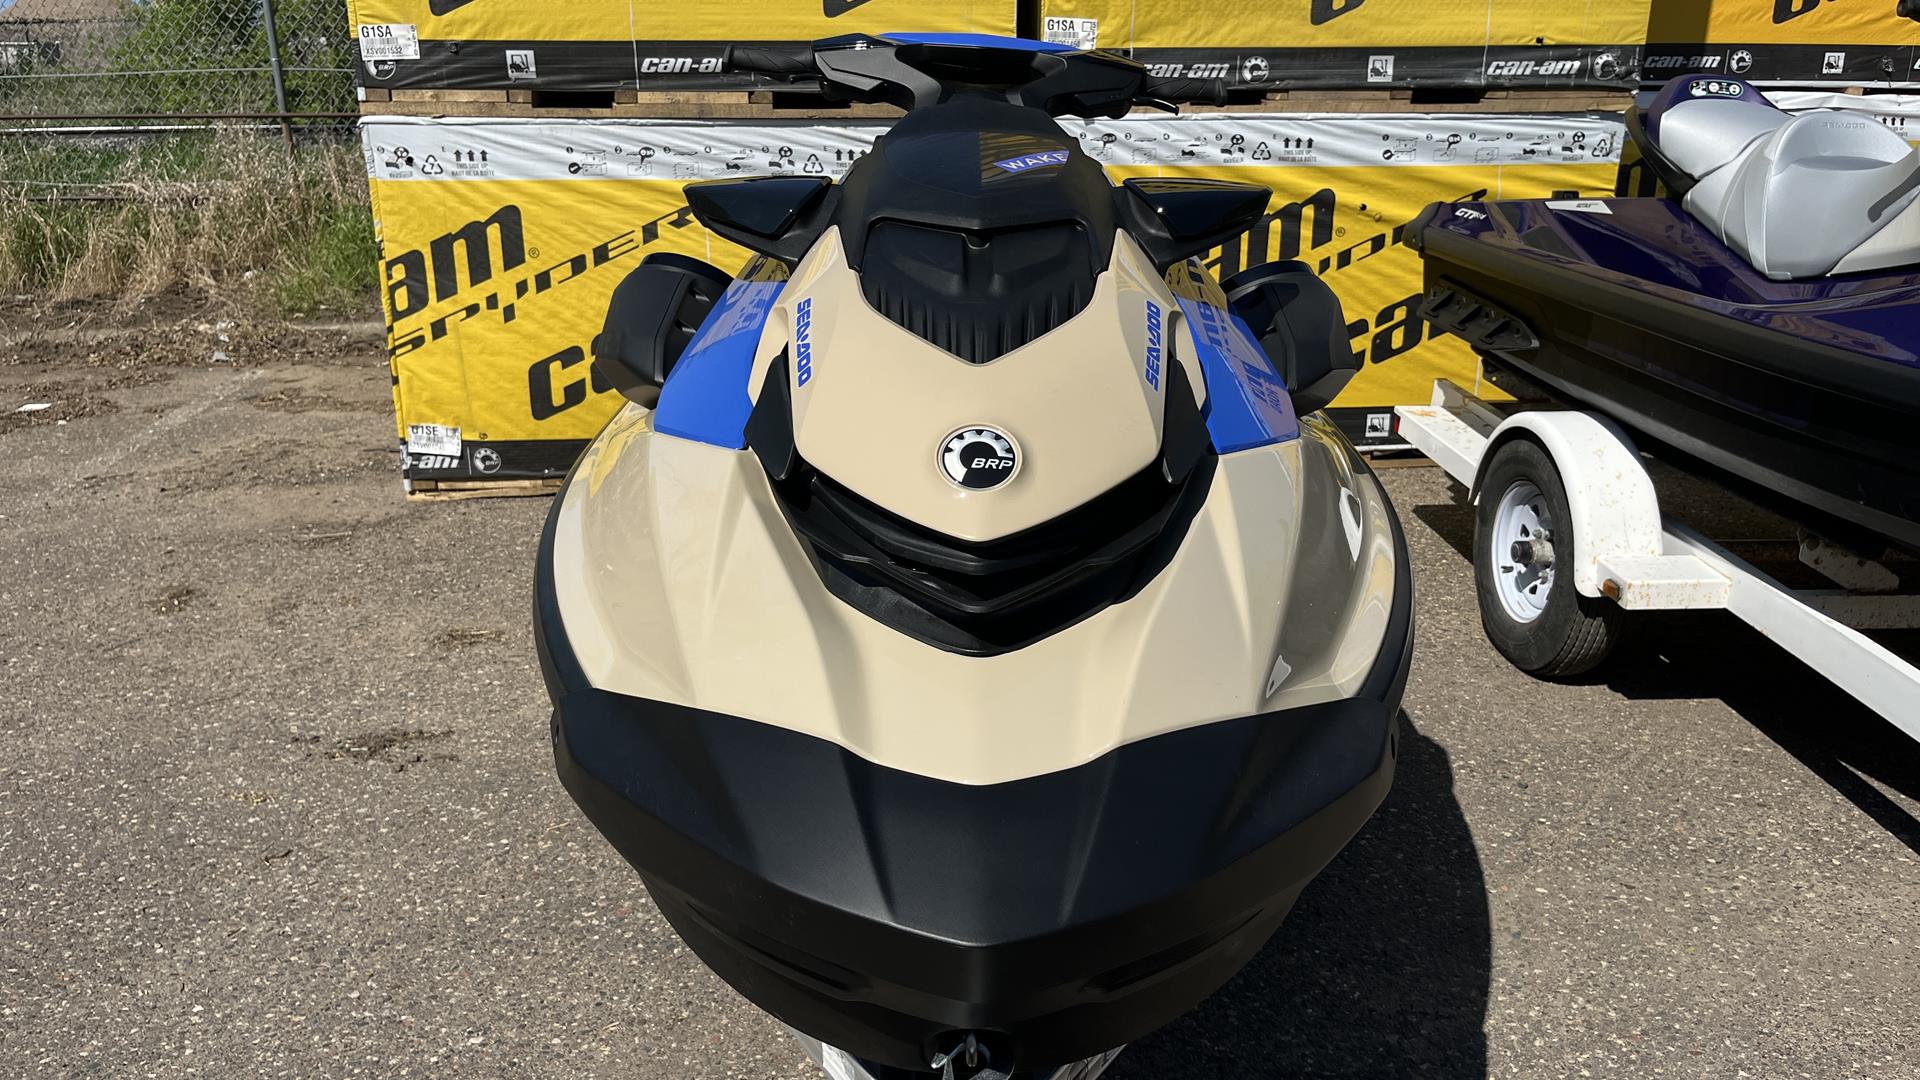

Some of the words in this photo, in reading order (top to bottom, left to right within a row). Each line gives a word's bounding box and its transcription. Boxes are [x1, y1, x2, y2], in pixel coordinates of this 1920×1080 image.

[1047, 18, 1075, 31] G1SA
[361, 25, 392, 38] G1SA
[1487, 60, 1581, 76] can-am
[1643, 55, 1721, 69] can-am
[1001, 153, 1068, 170] WAKE
[971, 457, 1013, 470] BRP
